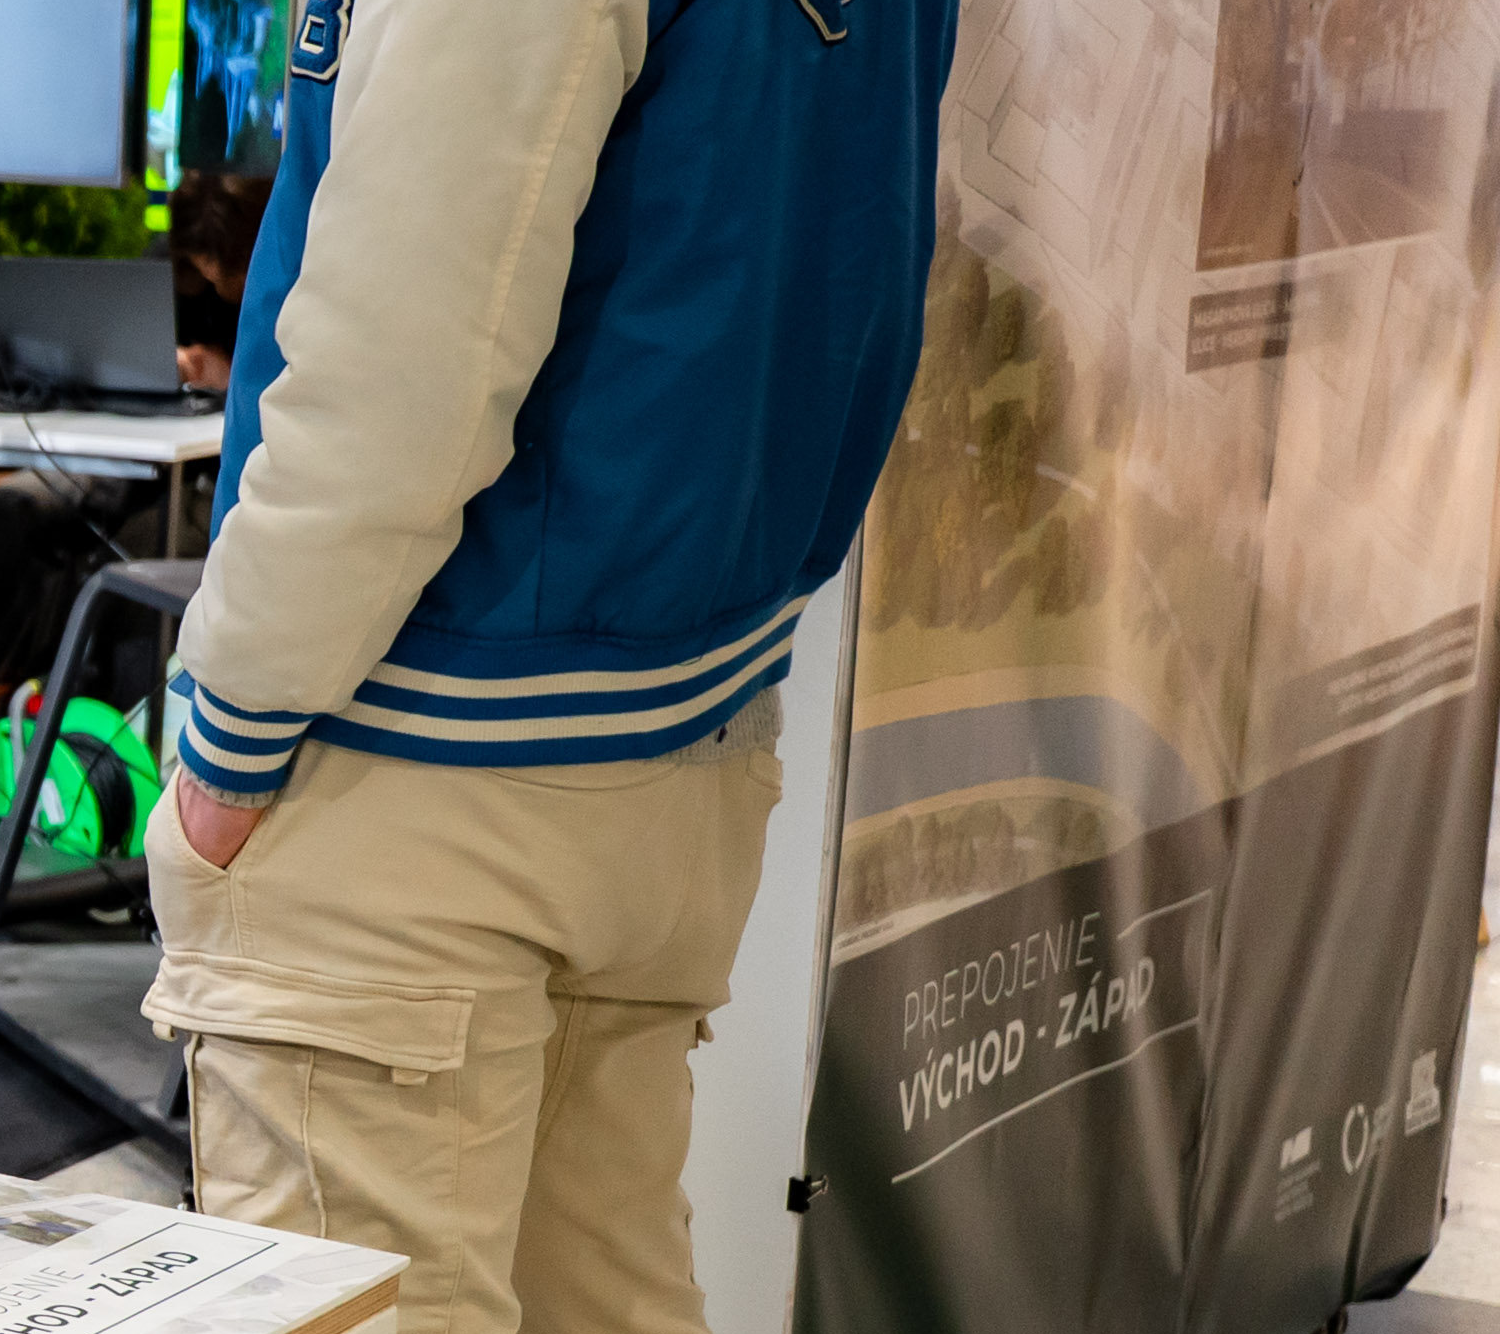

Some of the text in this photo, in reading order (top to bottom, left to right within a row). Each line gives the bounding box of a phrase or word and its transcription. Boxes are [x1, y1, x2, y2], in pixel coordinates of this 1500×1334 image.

[899, 1019, 1025, 1132] VÝCHOD
[1055, 956, 1155, 1049] ZÁPAD
[903, 911, 1100, 1051] PREPOJENIE
[90, 1251, 199, 1297] ZÁPAD
